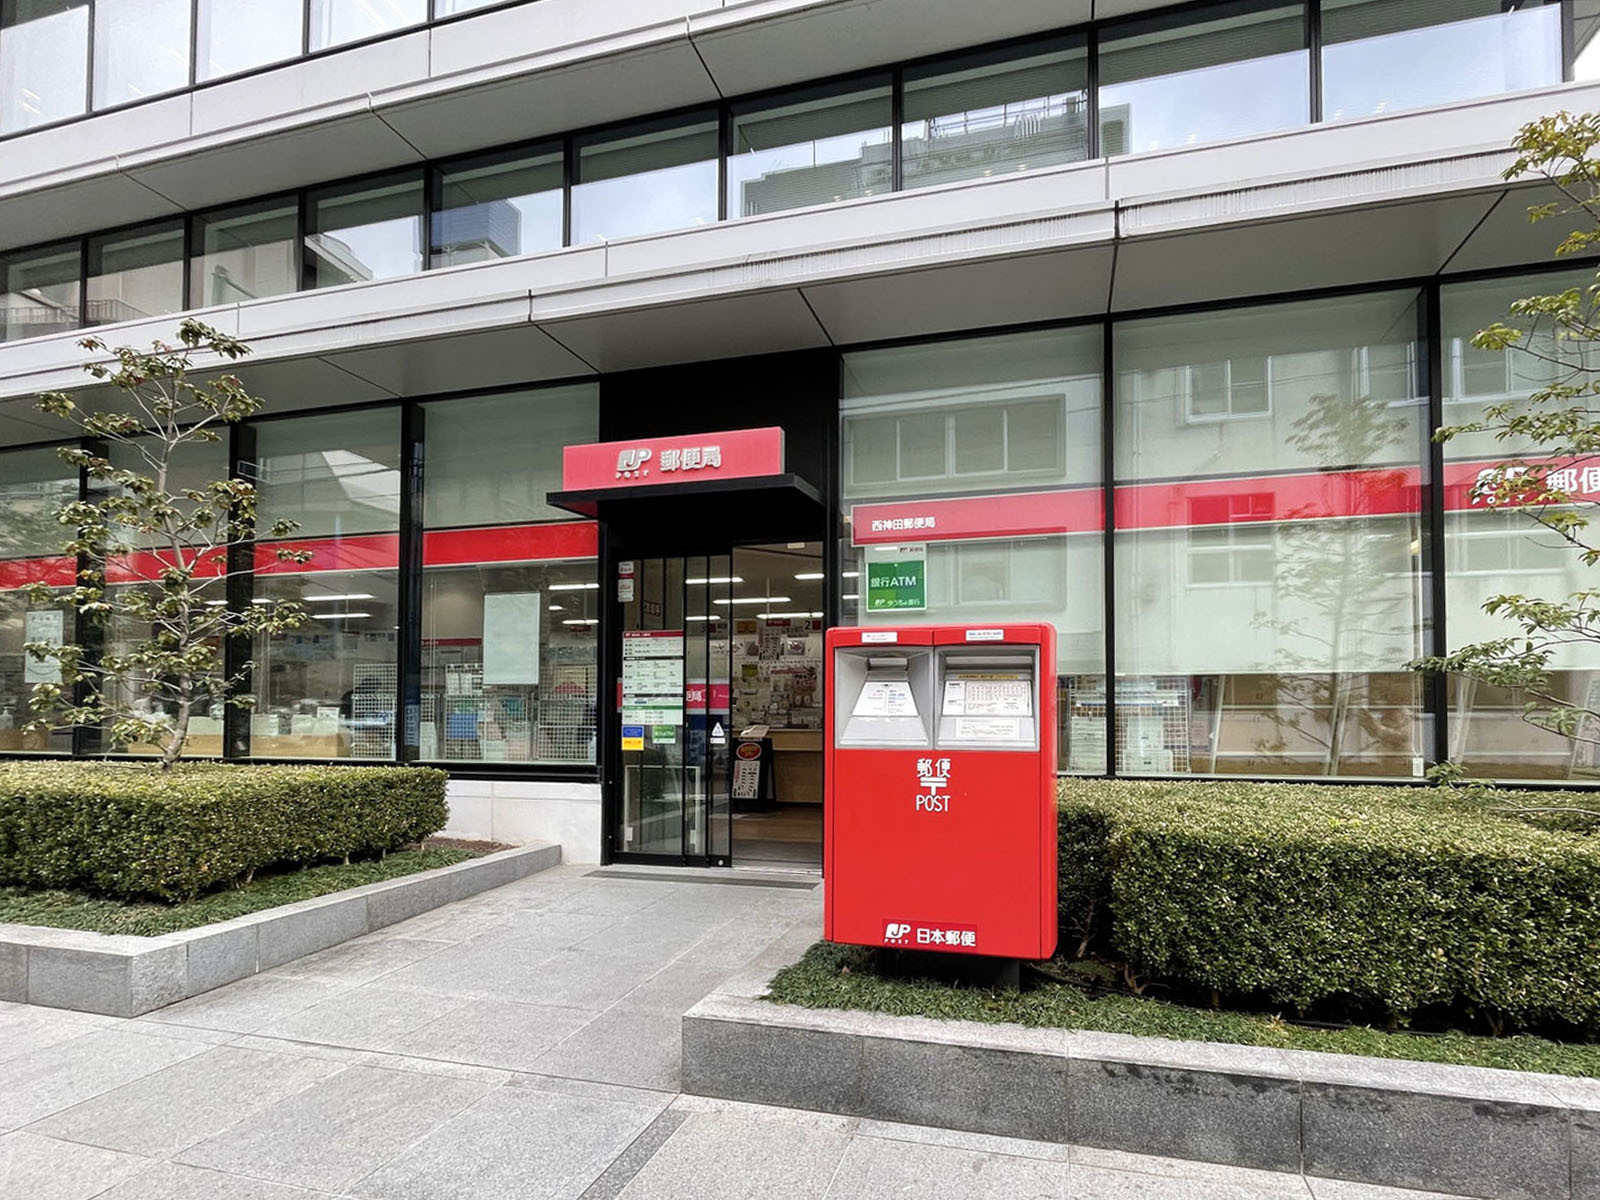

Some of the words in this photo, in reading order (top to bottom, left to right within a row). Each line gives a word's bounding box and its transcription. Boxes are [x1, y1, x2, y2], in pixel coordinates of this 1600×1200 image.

[660, 446, 722, 472] 郵便局
[615, 469, 650, 479] POST
[872, 517, 935, 532] 西神田郵便局
[871, 575, 917, 588] 銀行ATM
[916, 758, 952, 778] 郵便
[915, 795, 951, 812] POST
[916, 928, 977, 948] 日本郵便
